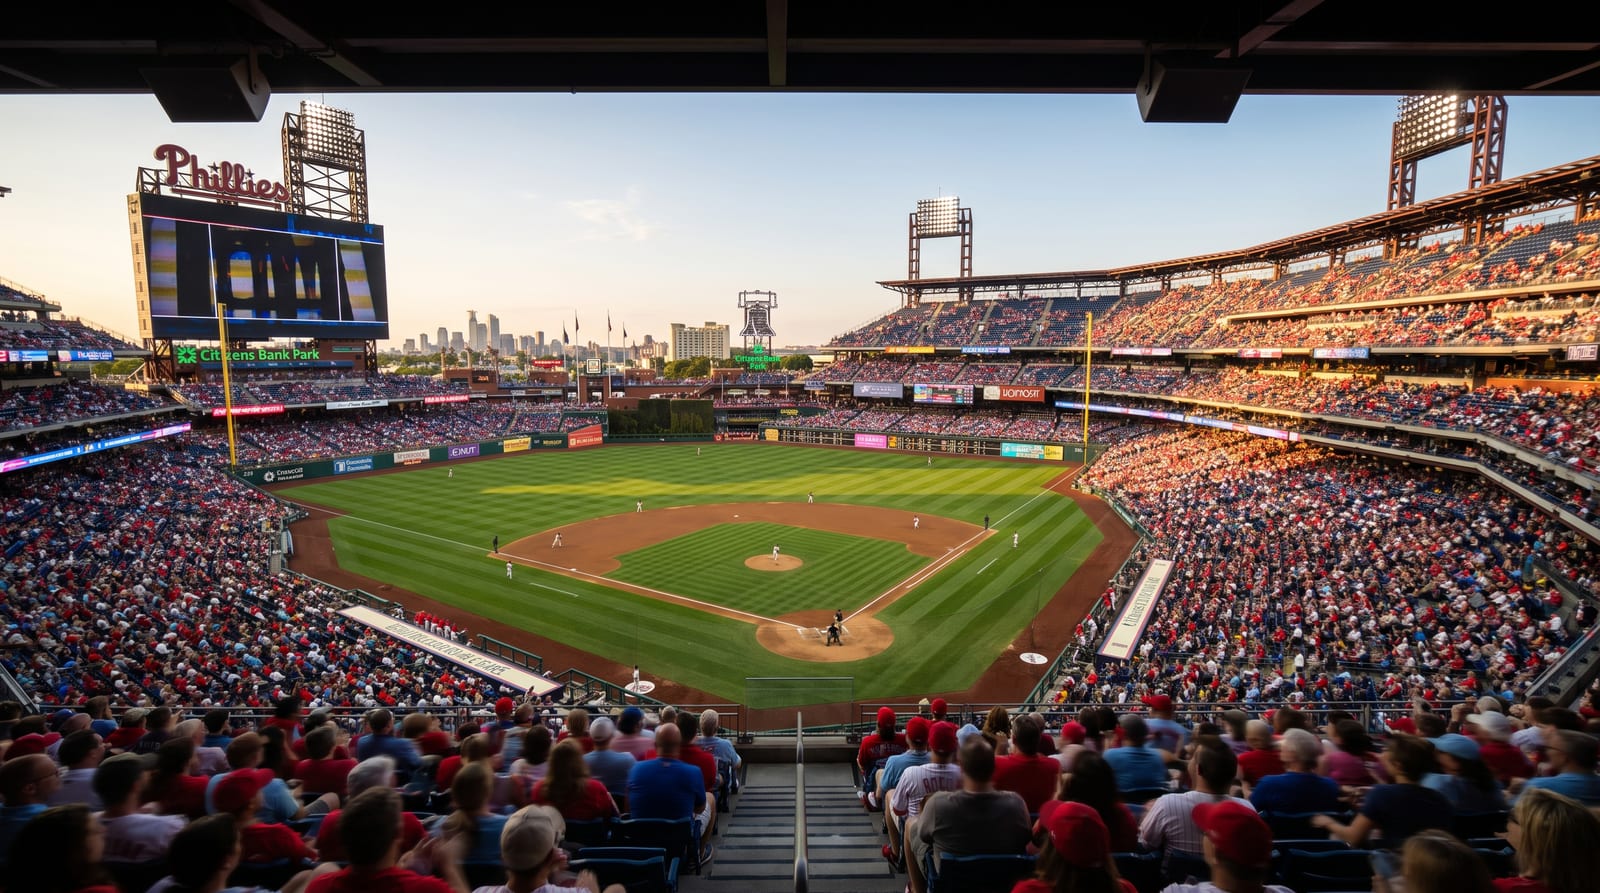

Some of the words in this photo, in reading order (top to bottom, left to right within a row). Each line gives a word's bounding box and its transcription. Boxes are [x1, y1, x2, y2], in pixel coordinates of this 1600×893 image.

[154, 144, 290, 202] Phillies
[200, 349, 256, 361] Citzens
[258, 348, 290, 361] Bank
[293, 348, 320, 360] Park
